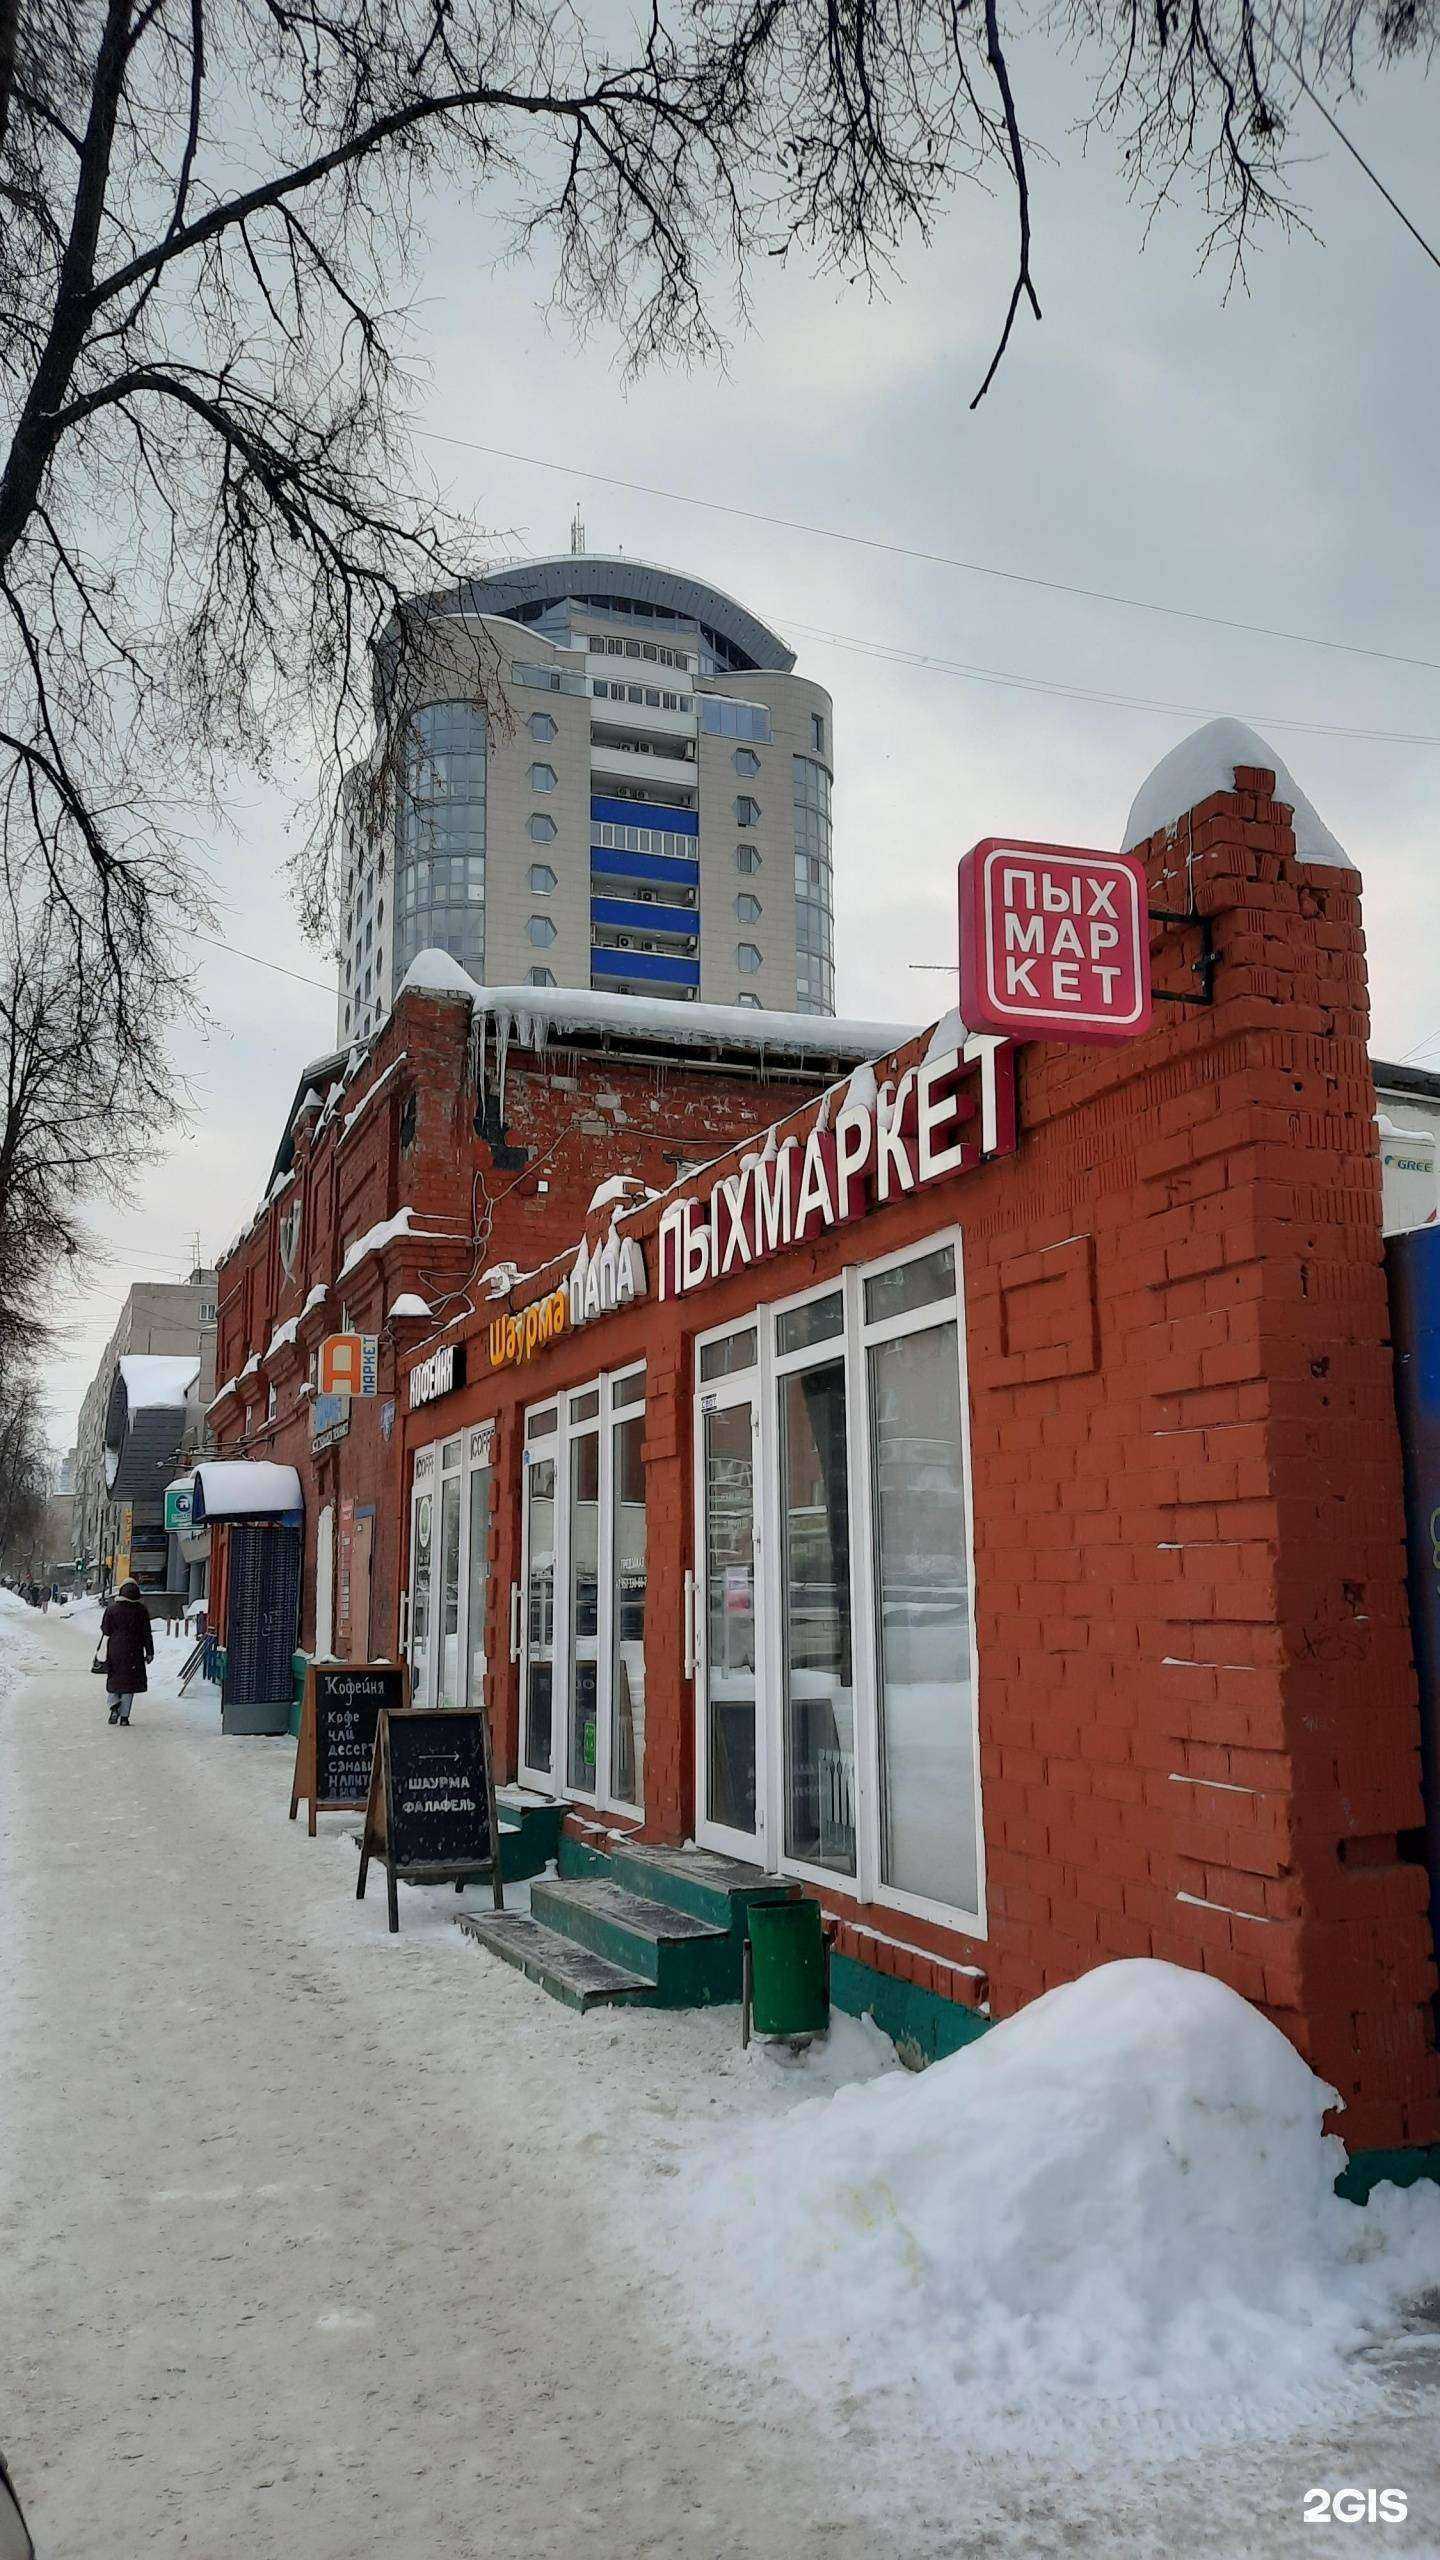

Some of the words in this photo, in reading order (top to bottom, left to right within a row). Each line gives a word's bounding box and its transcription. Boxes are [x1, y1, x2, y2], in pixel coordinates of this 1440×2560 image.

[1003, 868, 1119, 919] ПЫХ
[1005, 912, 1119, 960] МАР
[1006, 956, 1121, 1005] КЕТ
[658, 1036, 1010, 1302] ПЫХМАРКЕТ
[1397, 1159, 1433, 1173] GREE
[570, 1236, 636, 1325] ПАПА
[363, 1337, 376, 1394] МАРКЕТ
[325, 1676, 384, 1705] Кофейня
[402, 1793, 476, 1814] ФАЛАФЕЛЬ
[408, 1776, 470, 1790] ШАУРМА
